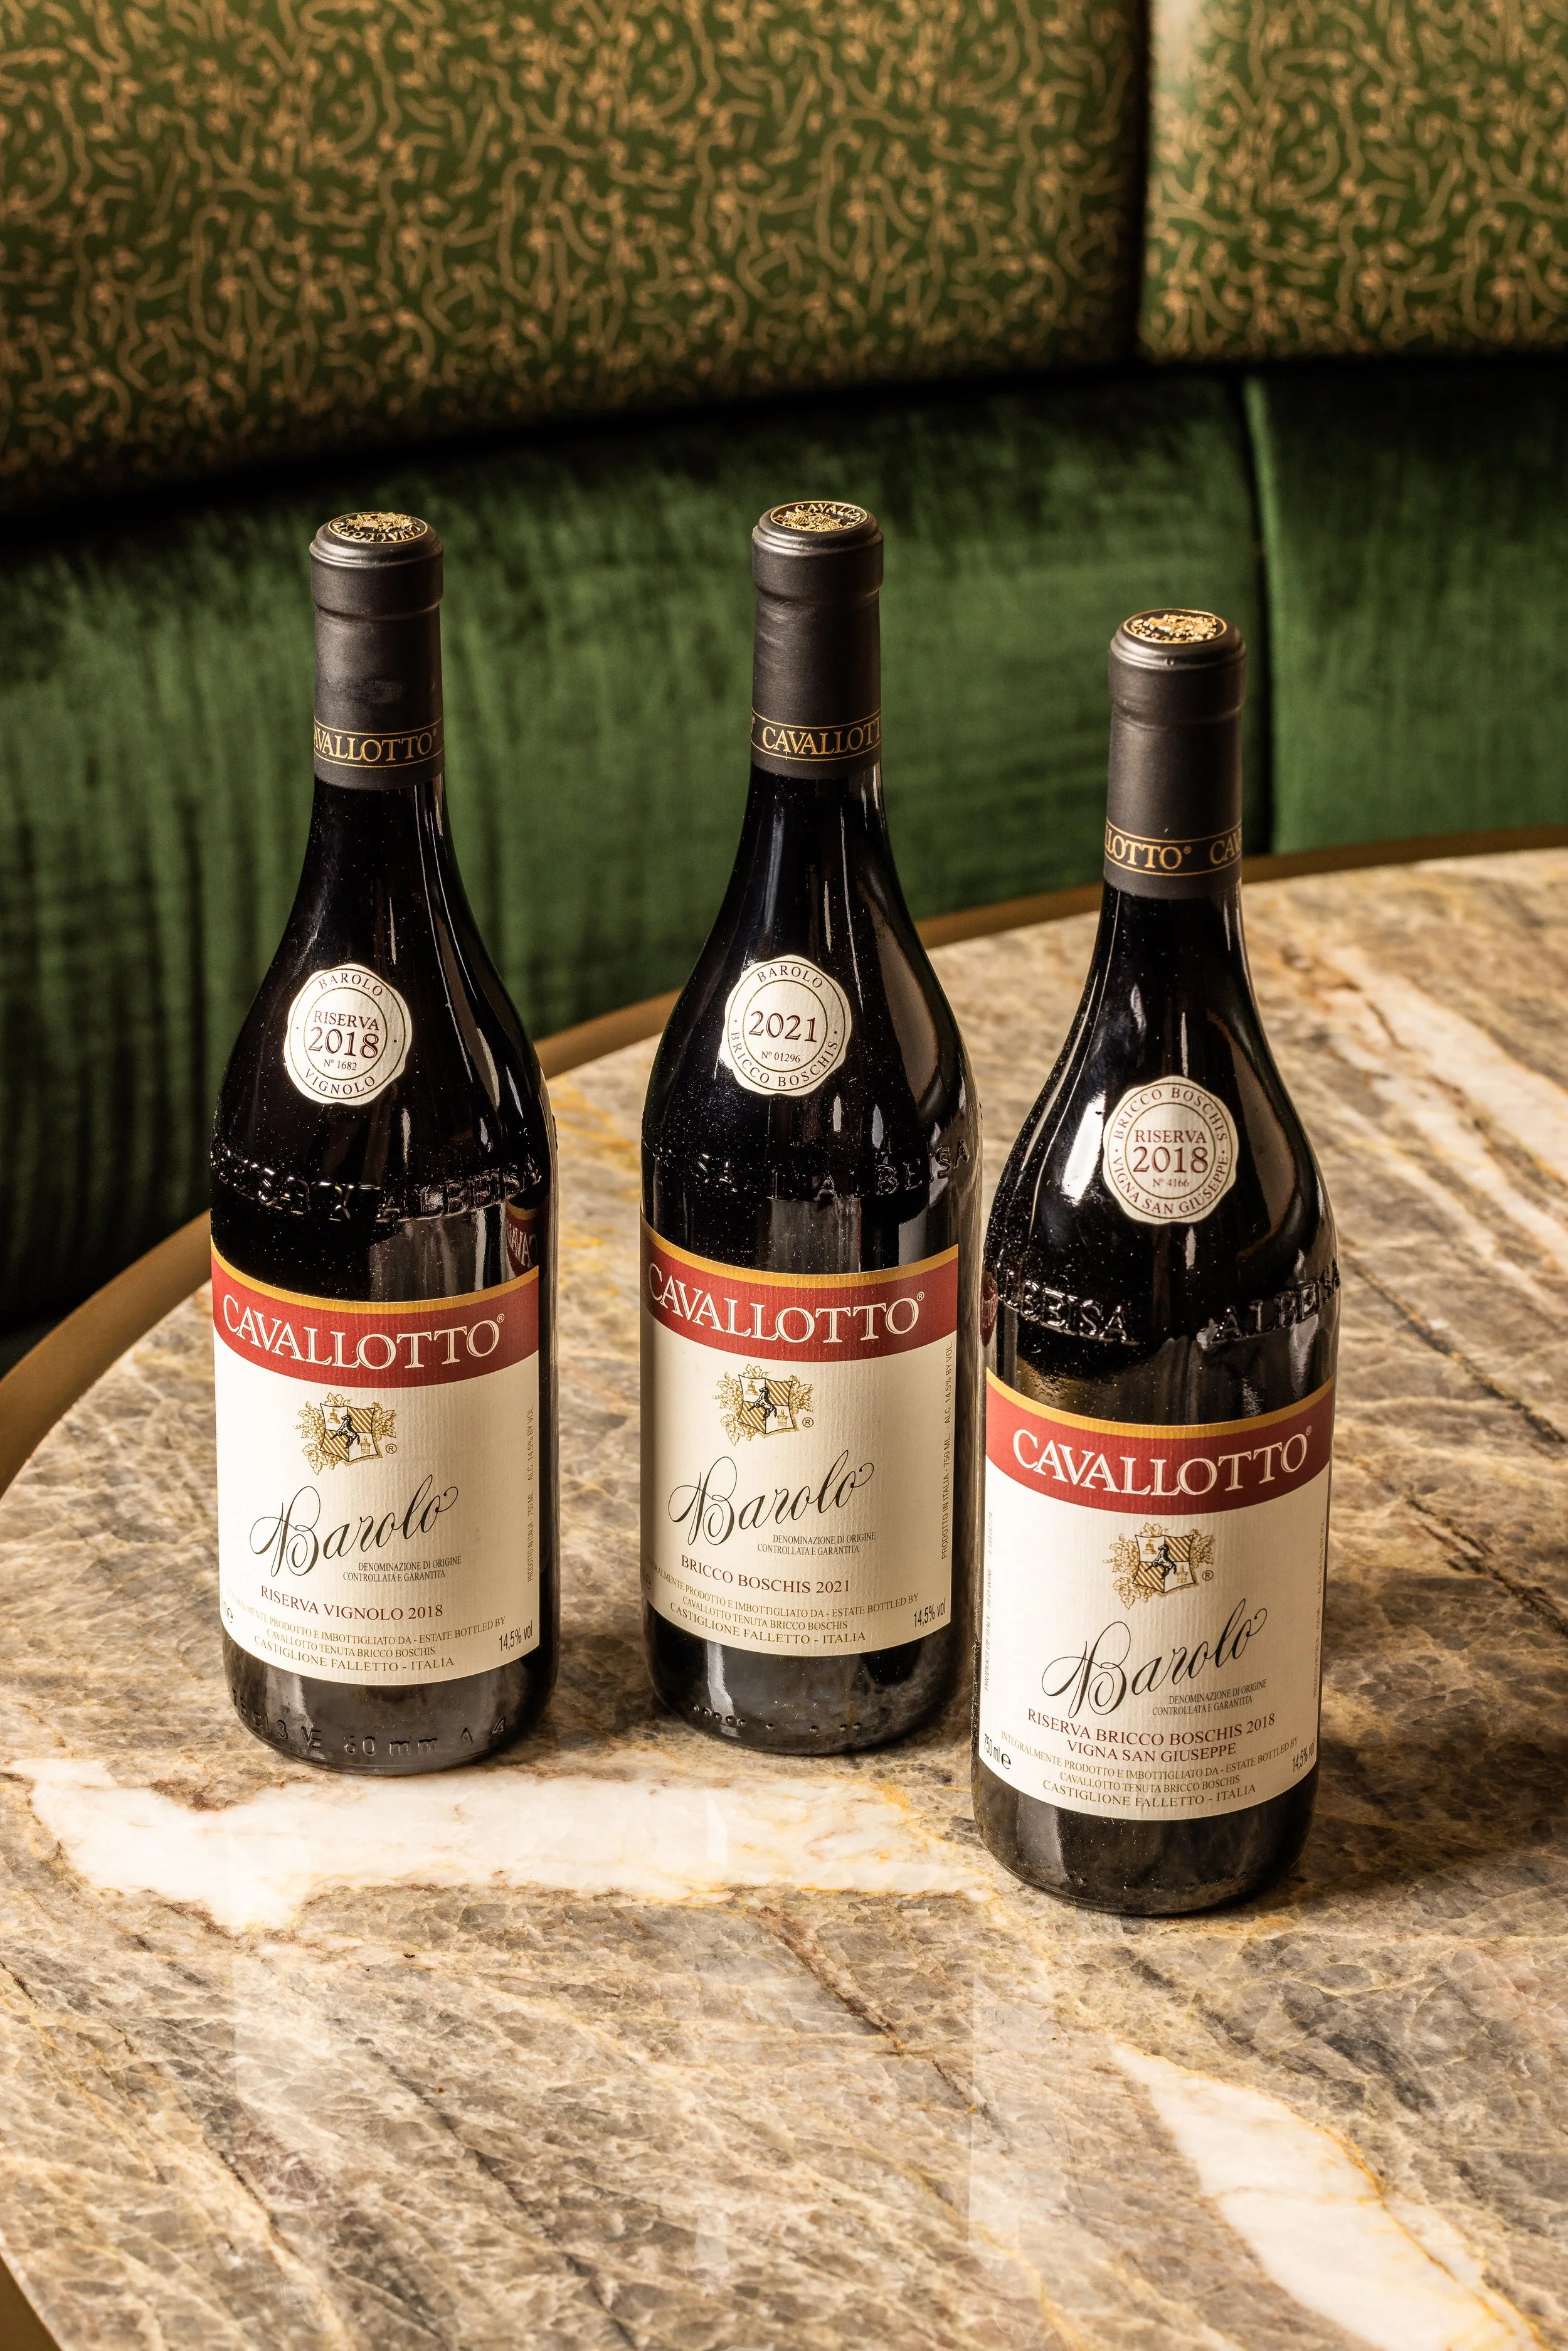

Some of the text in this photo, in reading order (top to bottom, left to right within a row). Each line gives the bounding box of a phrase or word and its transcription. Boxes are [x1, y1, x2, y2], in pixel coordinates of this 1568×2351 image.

[319, 973, 383, 997] BAROLO
[757, 965, 823, 989] BAROLO
[314, 1010, 380, 1031] RISERVA
[749, 1011, 817, 1043] 2021
[308, 1027, 380, 1059] 2018
[337, 1060, 358, 1071] 1682
[731, 1031, 838, 1087] BRICCO BOSCHIS
[775, 1052, 801, 1063] 01296
[305, 1068, 375, 1095] VIGNOLO
[1114, 1087, 1227, 1141] BRICCO BOSCHIS
[1135, 1130, 1207, 1144] RISERVA
[1133, 1146, 1209, 1173] 2018
[1113, 1156, 1228, 1214] VIGNA SAN GIUSEPPE
[1167, 1178, 1189, 1187] 4166
[946, 1365, 951, 1375] BY
[527, 1425, 534, 1436] BY
[668, 1450, 874, 1546] Barolo
[943, 1502, 950, 1513] IN
[249, 1474, 459, 1578] Barolo
[773, 1531, 876, 1545] DENOMINAZIONE DI ORIGINE
[941, 1513, 950, 1560] PRODOTTO
[527, 1541, 534, 1549] IN
[758, 1543, 859, 1556] CONTROLLATA E GARANTITA
[342, 1569, 445, 1583] CONTROLLATA E GARANTITA
[358, 1556, 462, 1572] DENOMINAZIONE DI ORIGINE
[681, 1554, 849, 1593] BRICCO BOSCHIS 2021
[261, 1585, 443, 1620] RISERVA VIGNOLO 2018
[683, 1596, 847, 1630] CAVALLOTTO TENUTA BRICCO BOSCHIS
[686, 1586, 726, 1606] PRODOTTO
[728, 1600, 733, 1608] E
[735, 1601, 808, 1618] IMBOTTIGLIATO
[810, 1610, 824, 1618] DA
[832, 1605, 866, 1617] ESTATE
[867, 1598, 907, 1613] BOTTLED
[908, 1593, 919, 1604] BY
[913, 1598, 946, 1628] 14,5% vol
[270, 1616, 312, 1637] PRODOTTO
[314, 1629, 319, 1638] E
[322, 1632, 396, 1645] IMBOTTIGLIATO
[398, 1637, 411, 1645] DA
[420, 1632, 452, 1643] ESTATE
[454, 1621, 493, 1638] BOTTLED
[495, 1616, 506, 1627] BY
[499, 1620, 533, 1652] 14,5% vol
[670, 1602, 866, 1644] CASTIGLIONE FALLETTO ITALIA
[255, 1635, 454, 1672] CASTIGLIONE FALLETTO ITALIA
[267, 1628, 435, 1658] CAVALLOTTO TENUTA BRICCO BOSCHIS
[1042, 1598, 1268, 1719] Barolo
[1169, 1679, 1267, 1704] DENOMINAZIONE DI ORIGINE
[1152, 1695, 1253, 1716] CONTROLLATA E GARANTITA
[1028, 1708, 1274, 1746] RISERVA BRICCO BOSCHIS 2018
[984, 1733, 1000, 1763] 750 ml
[1001, 1730, 1299, 1780] INTEGRALMENTE PRODOTTO E IMBOTTIGLIATO DA ESTATE BOTTLED BY
[1067, 1739, 1236, 1763] VIGNA SAN GIUSEPPE
[1292, 1746, 1308, 1773] 14,5%
[1043, 1780, 1256, 1807] CASTIGLIONE FALLETTO ITALIA
[1060, 1771, 1240, 1793] CAVALLOTTO TENUTA BRICCO BOSCHIS
